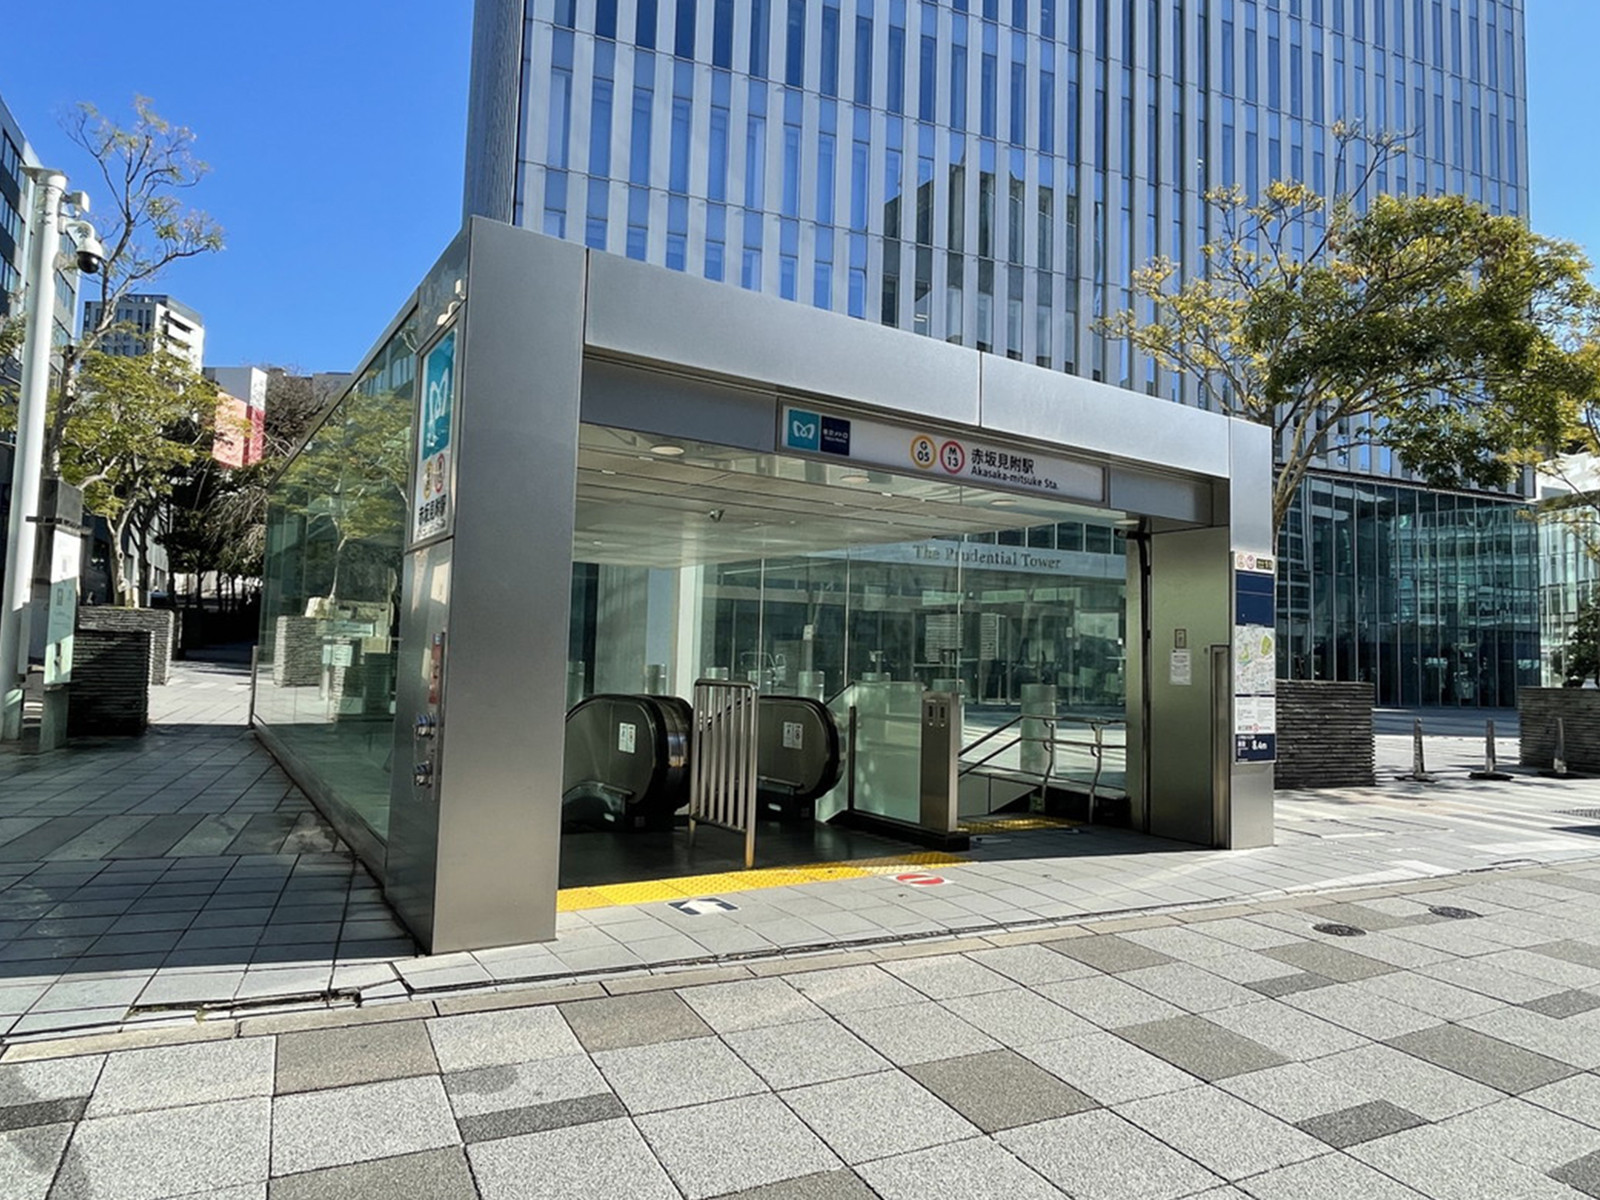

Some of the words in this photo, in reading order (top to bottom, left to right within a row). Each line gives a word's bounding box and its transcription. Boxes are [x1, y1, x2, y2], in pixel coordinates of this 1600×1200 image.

[919, 440, 928, 451] G
[948, 447, 958, 456] M
[917, 450, 931, 463] 05
[946, 456, 959, 468] 13
[971, 448, 1035, 475] 赤坂見附駅
[971, 466, 1042, 488] Akasaka-mitsuke
[1044, 478, 1059, 490] Sta.
[912, 544, 940, 561] The
[945, 547, 1017, 566] Prudential
[1021, 553, 1062, 569] Tower
